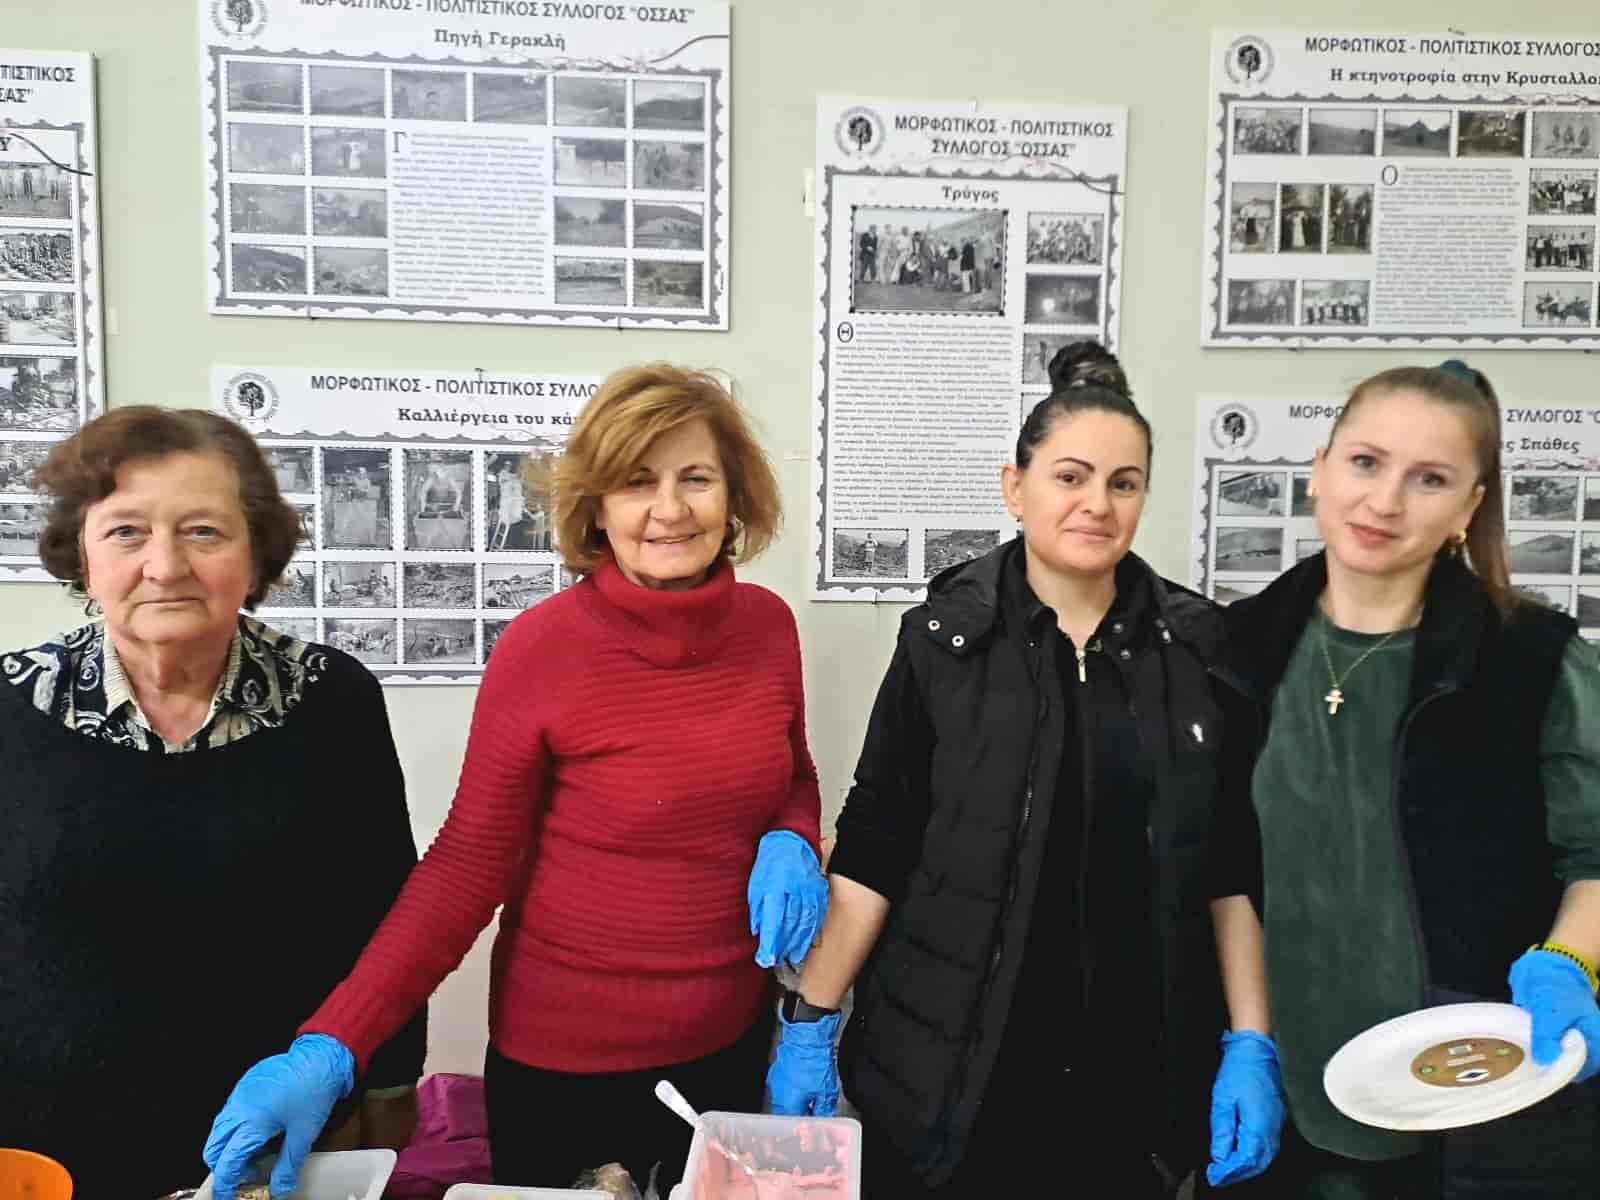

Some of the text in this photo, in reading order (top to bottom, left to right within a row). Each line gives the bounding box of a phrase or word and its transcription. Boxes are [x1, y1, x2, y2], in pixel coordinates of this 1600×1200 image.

[426, 0, 540, 17] ΠΟΛΙΤΙΣΤΙΚΟΣ
[543, 2, 625, 20] ΣΥΛΛΟΓΟΣ
[434, 29, 566, 50] Πηγή Γερακλή
[1305, 37, 1407, 54] ΜΟΡΦΩΤΙΚΟΣ
[1420, 39, 1521, 56] ΠΟΛΙΤΙΣΤΙΚΟΣ
[1526, 41, 1600, 57] ΣΥΛΛΟΓΟΣ
[1330, 68, 1600, 87] Η κτηνοτροφία στην Κρυσταλλο
[895, 115, 998, 134] ΜΟΡΦΩΤΙΚΟΣ
[1010, 119, 1114, 138] ΠΟΛΙΤΙΣΤΙΚΟΣ
[931, 138, 1010, 155] ΣΥΛΛΟΓΟΣ
[941, 185, 999, 202] Τρύγος
[311, 375, 421, 393] ΜΟΡΦΩΤΙΚΟΣ
[436, 379, 545, 397] ΠΟΛΙΤΙΣΤΙΚΟΣ
[398, 408, 508, 426] Καλλιέργεια
[514, 414, 544, 425] του
[1506, 409, 1583, 424] ΣΥΛΛΟΓΟΣ
[1520, 437, 1580, 454] Σπάθες
